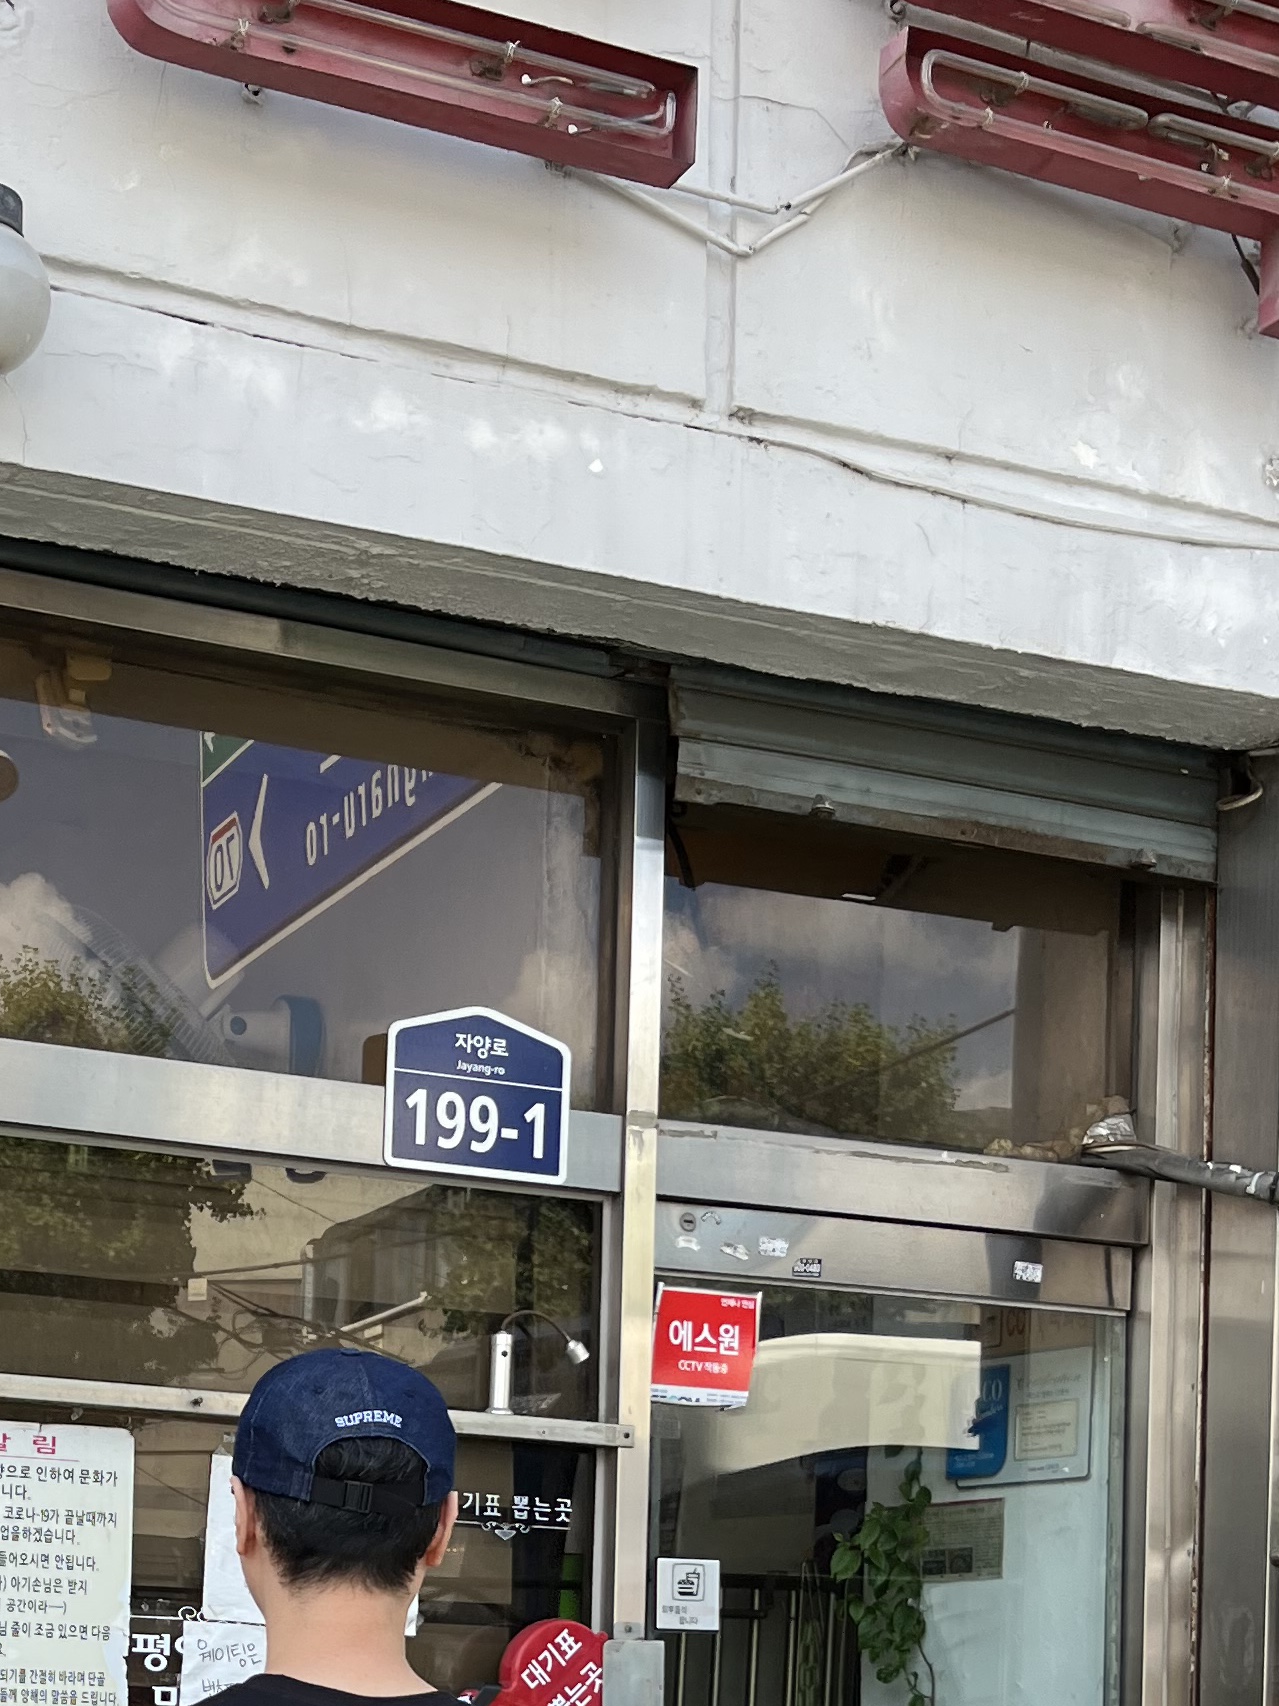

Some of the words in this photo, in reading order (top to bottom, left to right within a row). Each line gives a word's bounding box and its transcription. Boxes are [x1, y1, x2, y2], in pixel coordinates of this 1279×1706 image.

[455, 1033, 509, 1059] 자양로
[456, 1060, 506, 1076] Jayang-ro
[406, 1088, 545, 1159] 199-1
[669, 1320, 739, 1356] 에스원
[678, 1359, 704, 1372] CCTV
[334, 1409, 403, 1429] SUPREME
[32, 1435, 57, 1455] 림
[36, 1465, 75, 1484] 인하여
[78, 1468, 118, 1487] 문화가
[3, 1506, 60, 1525] 코로나-19가
[455, 1491, 502, 1518] 기표
[511, 1494, 573, 1523] 뽑는곳
[10, 1576, 64, 1594] 아기손님은
[67, 1579, 88, 1596] 받지
[33, 1622, 55, 1639] 조금
[57, 1623, 88, 1640] 있으면
[91, 1625, 111, 1641] 다음
[520, 1627, 583, 1690] 대기표
[29, 1668, 56, 1684] 간절히
[58, 1670, 85, 1686] 바라며
[88, 1671, 106, 1687] 단골
